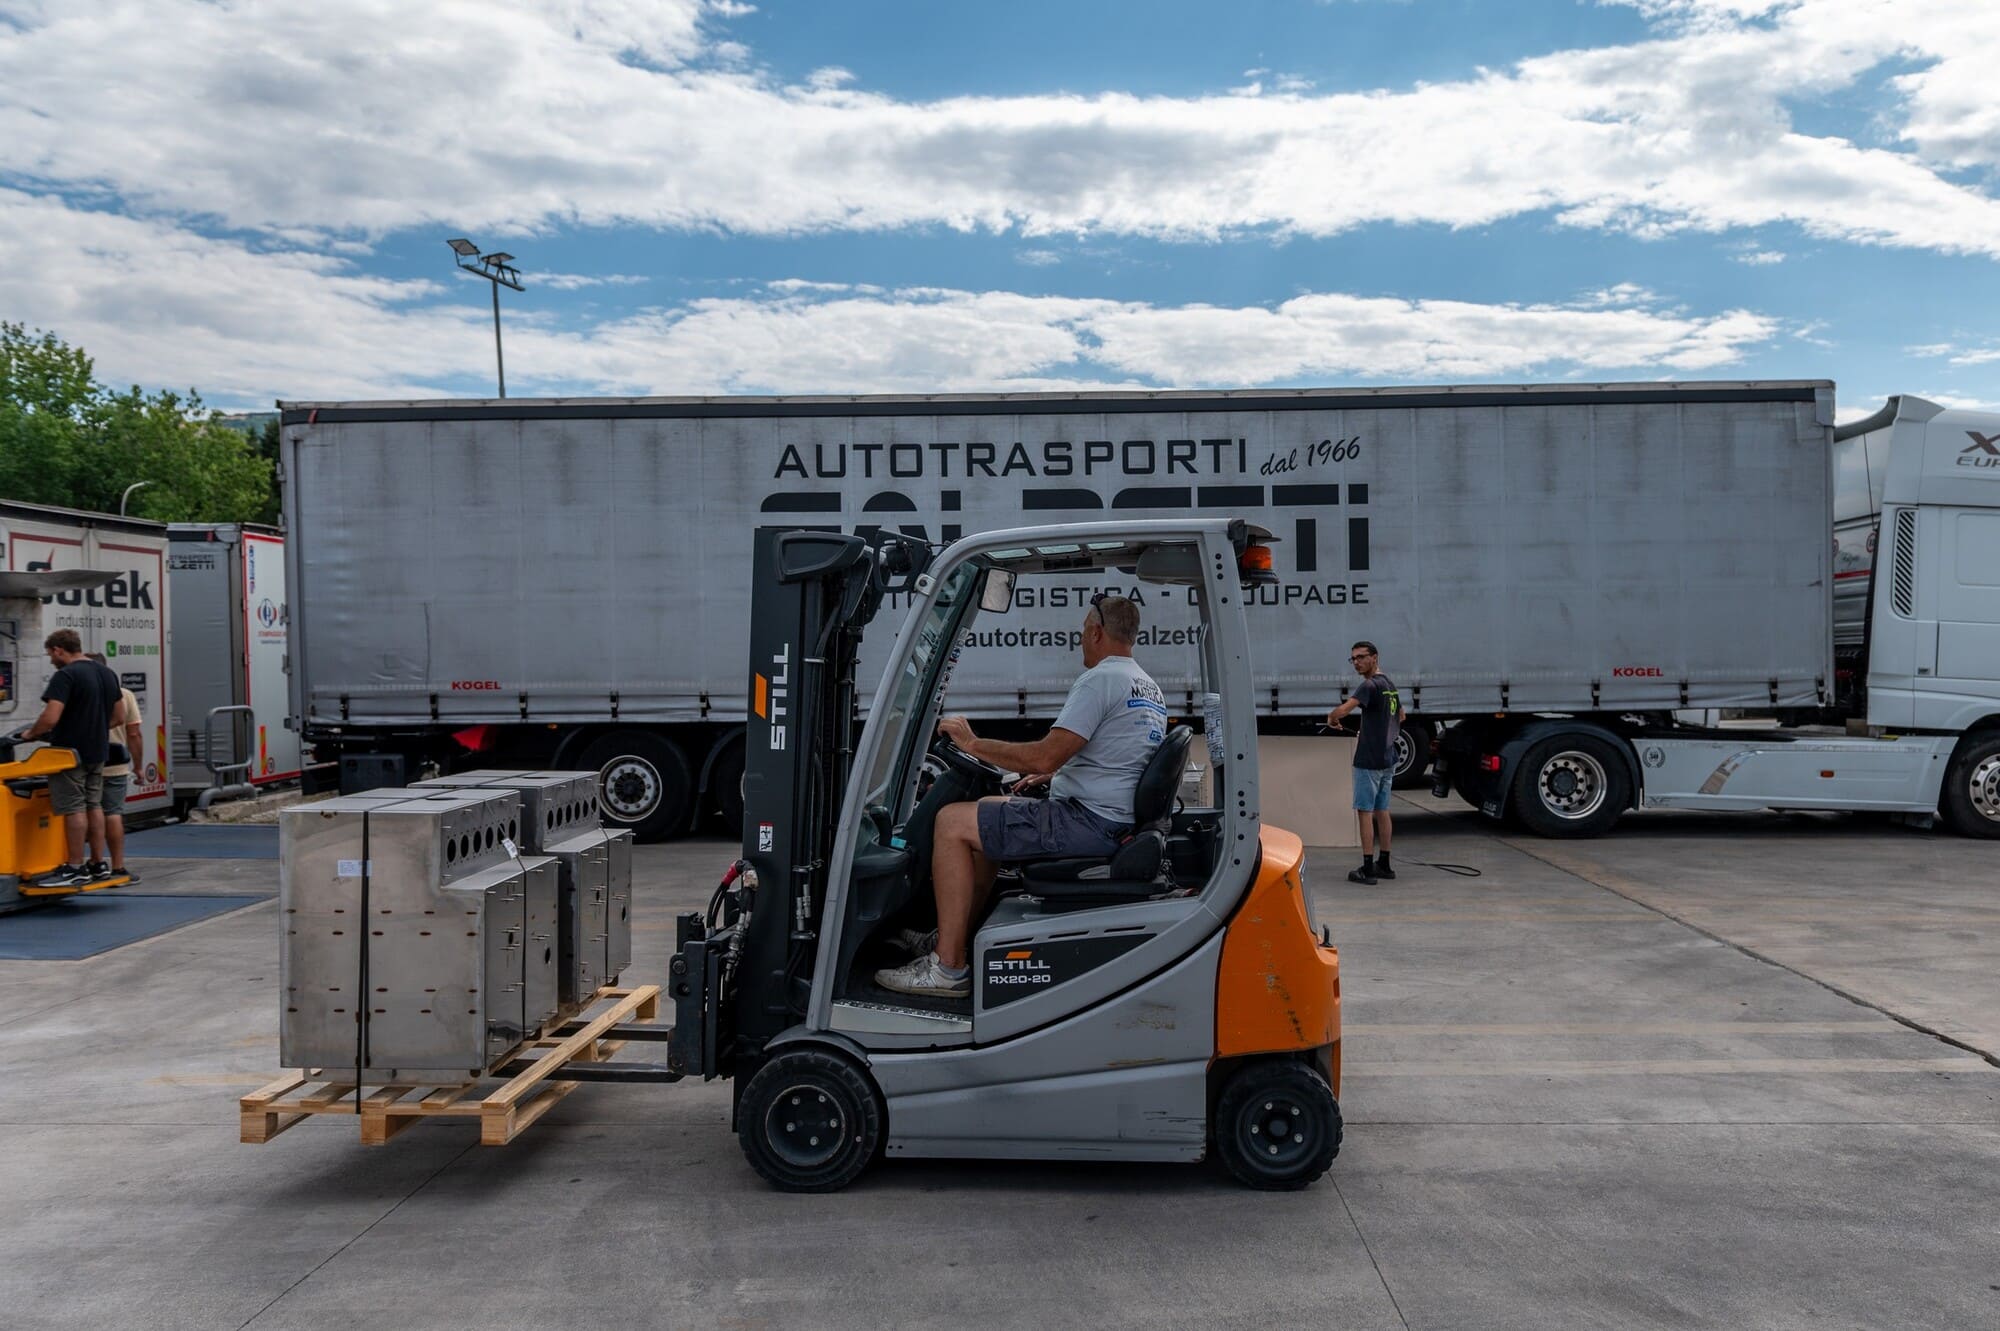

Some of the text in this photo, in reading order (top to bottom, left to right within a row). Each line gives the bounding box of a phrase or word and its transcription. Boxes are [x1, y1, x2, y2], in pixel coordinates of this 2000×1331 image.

[774, 436, 1360, 478] AUTOTRASPORTI dal 1966
[1015, 586, 1146, 608] GISTCA
[56, 613, 155, 629] industrial solutions
[771, 643, 789, 750] STILL
[988, 960, 1051, 970] STILL
[989, 975, 1051, 984] RX20-20
